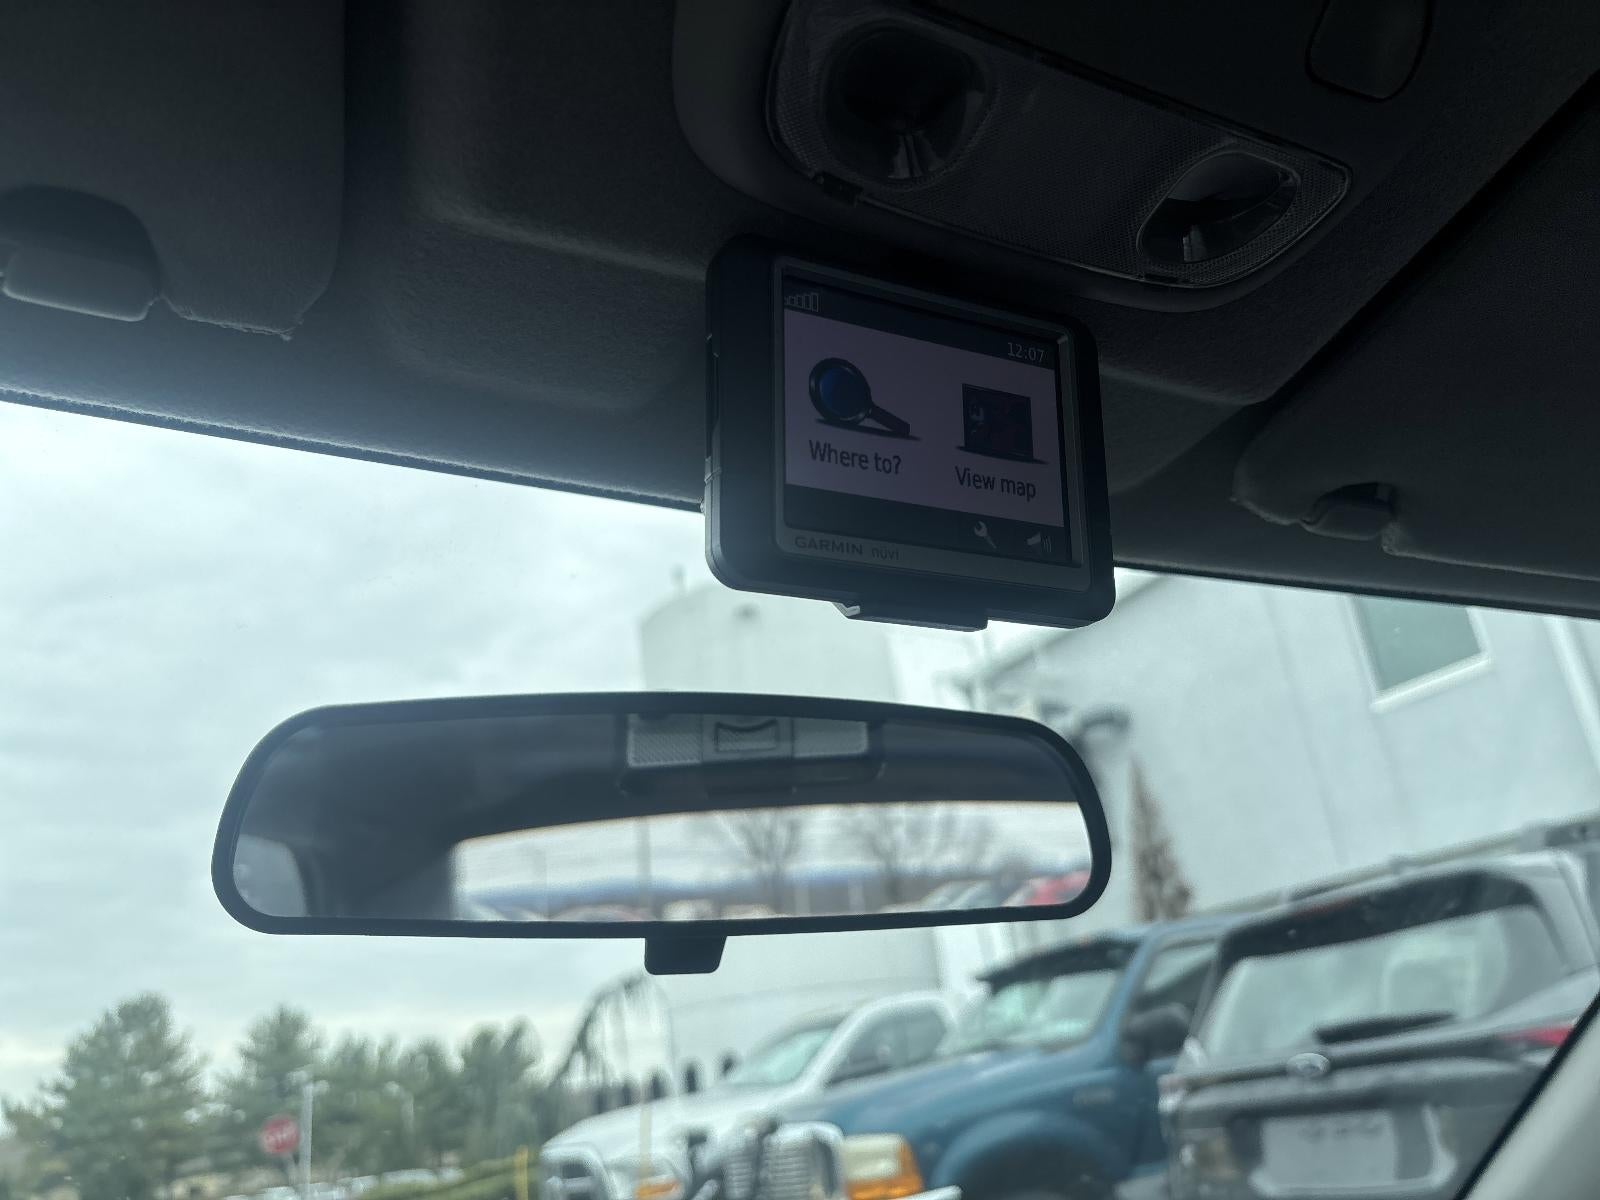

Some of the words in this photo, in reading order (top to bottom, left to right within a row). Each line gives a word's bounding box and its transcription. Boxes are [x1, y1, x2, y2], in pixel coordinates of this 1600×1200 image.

[1007, 342, 1045, 362] 12:07
[809, 439, 869, 470] Where
[875, 452, 902, 475] to?
[954, 466, 996, 490] View
[1000, 477, 1037, 502] map
[794, 536, 864, 555] GARMIN
